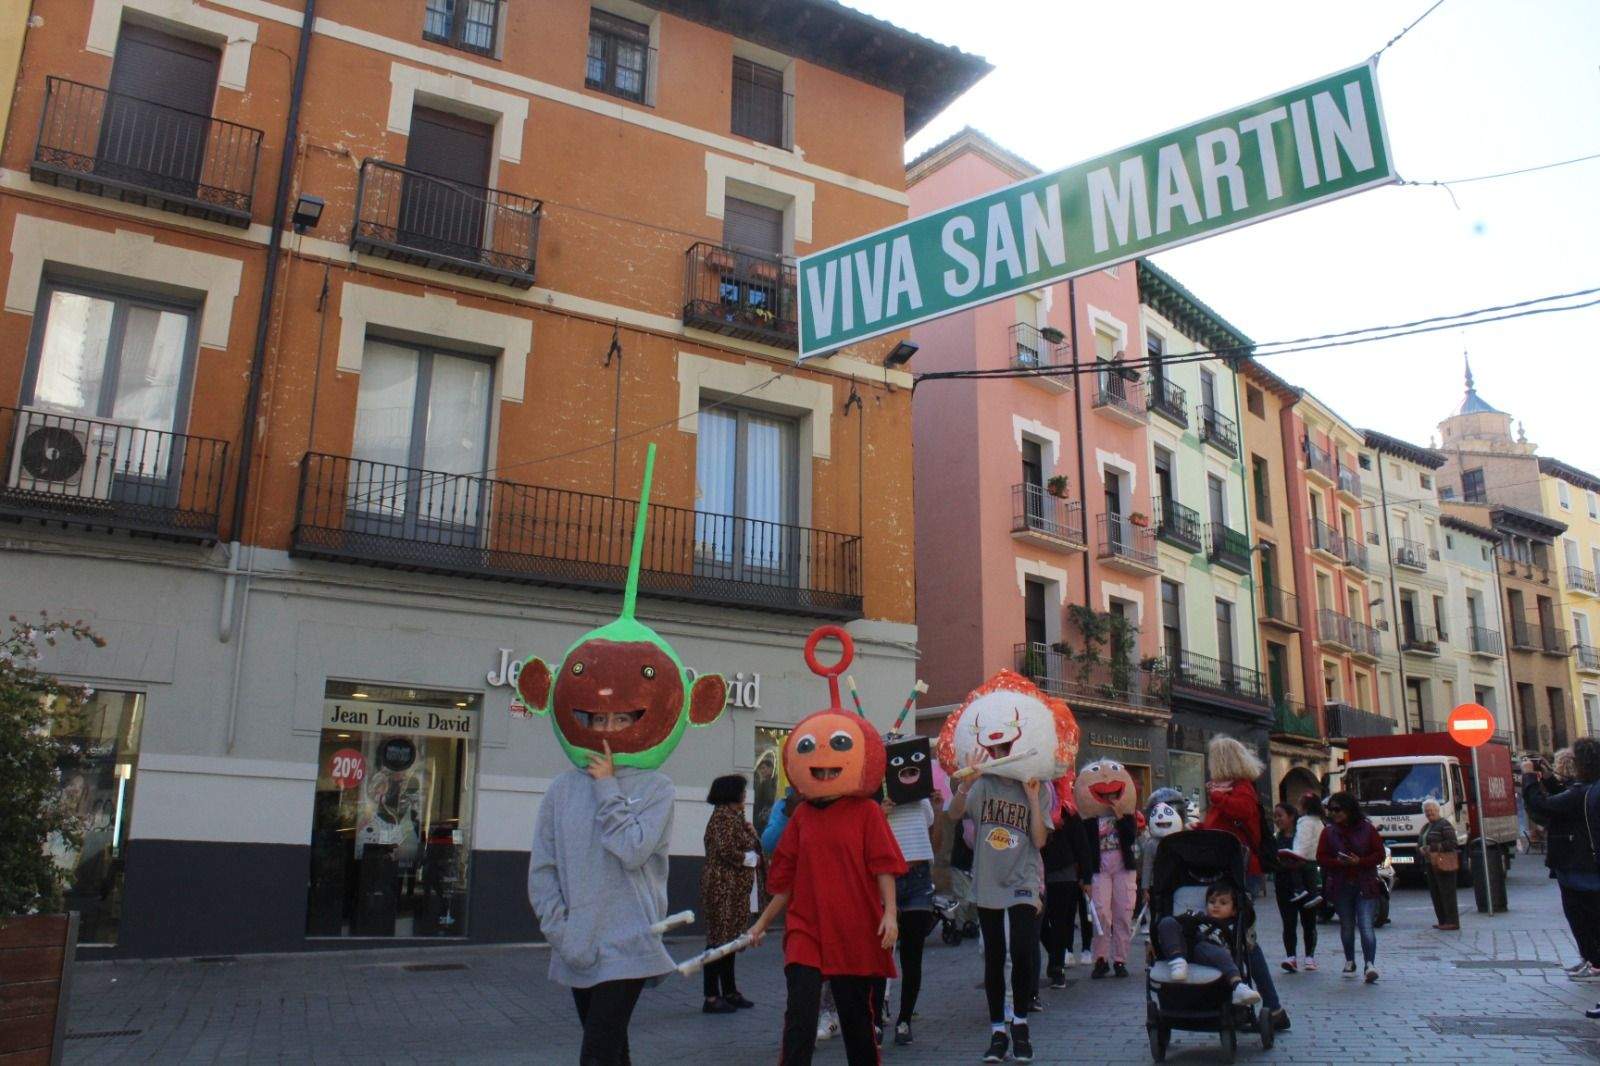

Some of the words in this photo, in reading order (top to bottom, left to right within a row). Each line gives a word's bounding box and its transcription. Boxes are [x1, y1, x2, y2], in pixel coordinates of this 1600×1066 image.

[806, 235, 923, 340] VIVA
[940, 184, 1066, 298] SAN
[1086, 80, 1376, 253] MARTIN
[331, 705, 368, 724] Jean
[377, 709, 420, 728] Louis
[428, 712, 471, 732] David
[332, 756, 363, 780] 20%
